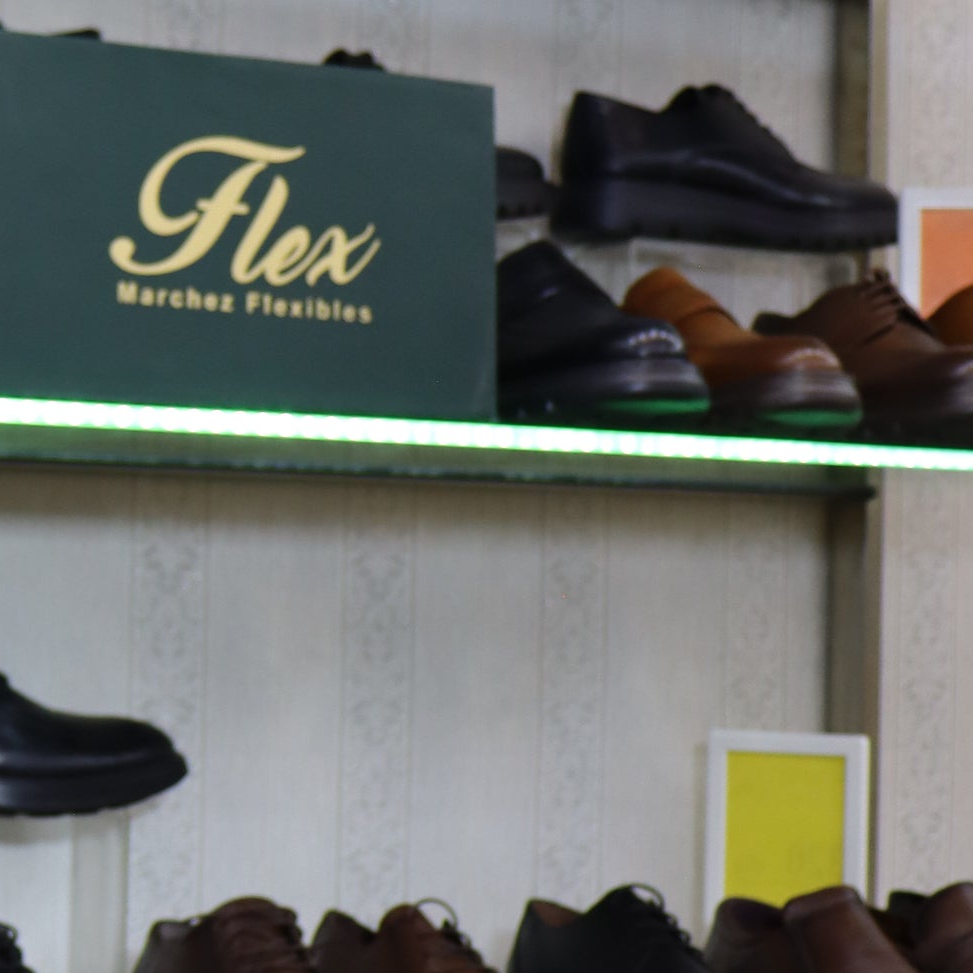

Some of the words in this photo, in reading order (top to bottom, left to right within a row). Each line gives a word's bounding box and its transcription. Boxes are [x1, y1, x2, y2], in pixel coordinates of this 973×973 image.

[109, 135, 380, 286] Flex
[117, 281, 234, 313] Marchez
[246, 291, 372, 323] Flexibles
